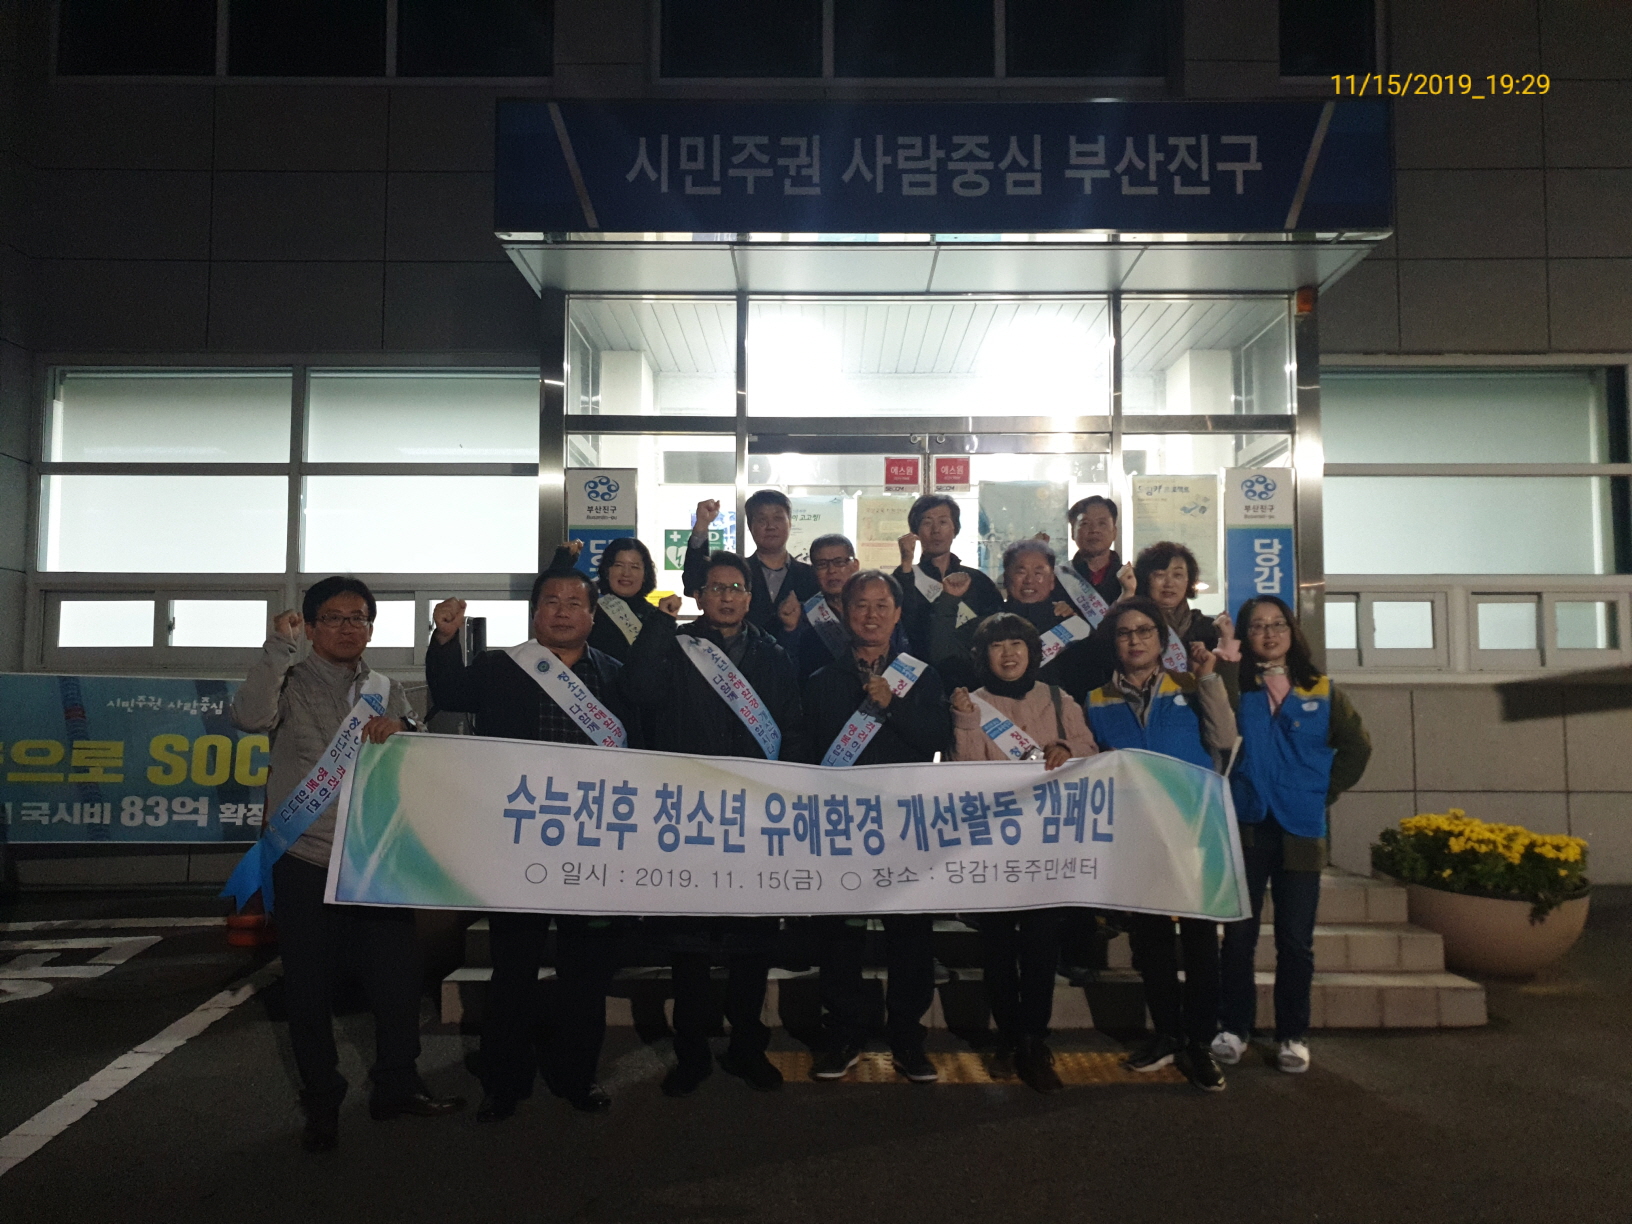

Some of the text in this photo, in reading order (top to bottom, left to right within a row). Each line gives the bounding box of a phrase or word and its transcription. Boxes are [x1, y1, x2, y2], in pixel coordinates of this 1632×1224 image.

[625, 134, 1263, 196] 시민주권 사람중심 부산진구
[891, 466, 914, 476] 에스원
[941, 465, 964, 475] 에스원
[586, 505, 617, 514] 부산진구
[1244, 504, 1275, 513] 부산진구
[1253, 538, 1283, 594] 당감
[556, 671, 587, 702] 청소년
[586, 702, 622, 738] 유해환경
[712, 674, 739, 702] 다함께
[727, 671, 759, 709] 유해환경
[106, 695, 162, 713] 시민주권
[168, 696, 224, 715] 사람중심
[569, 703, 601, 733] 다함께
[0, 734, 269, 786] 으로 SOC
[827, 723, 858, 766] 행복합니
[21, 802, 111, 825] 국시비
[120, 796, 209, 827] 83억
[503, 774, 1114, 857] 수능전후 청소년 유해환경 개선활동 캠페인
[561, 861, 607, 887] 일시
[635, 868, 699, 888] 2019.
[712, 870, 744, 889] 11.
[757, 868, 823, 892] 15(금)
[872, 866, 919, 888] 장소
[945, 857, 1099, 884] 당감1동주민센터
